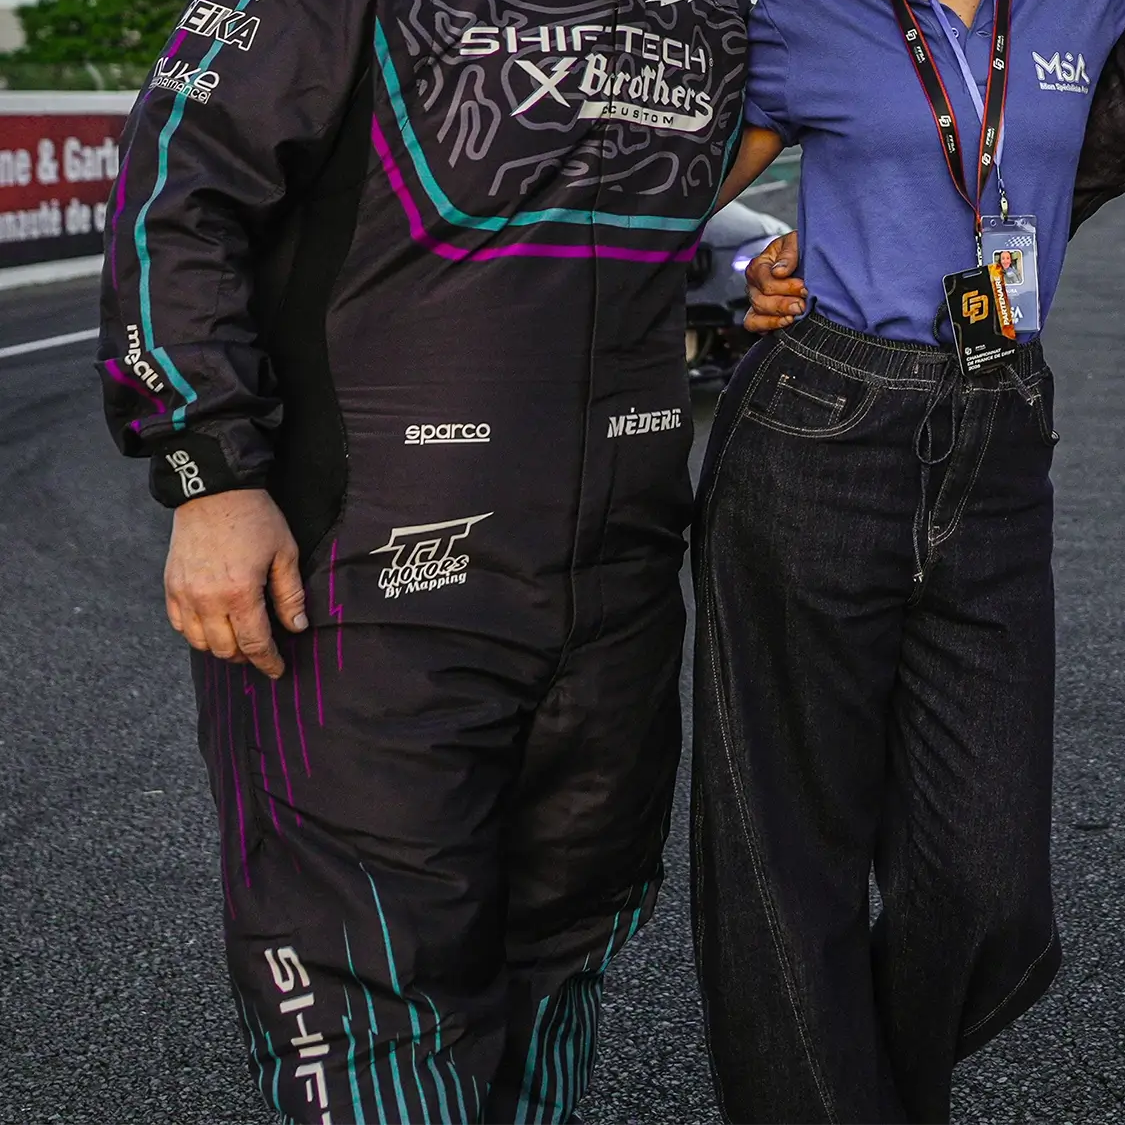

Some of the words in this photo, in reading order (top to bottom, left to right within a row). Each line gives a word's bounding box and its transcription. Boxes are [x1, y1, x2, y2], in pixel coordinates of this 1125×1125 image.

[459, 25, 707, 73] SHIFTECH
[511, 56, 578, 117] X
[578, 53, 714, 121] Brothers
[36, 137, 59, 184] &
[994, 276, 1011, 326] PARTENAIRE
[966, 348, 1001, 361] CHAMPIONNAT
[974, 355, 994, 364] FRANCE
[1001, 349, 1015, 357] DRIFT
[405, 423, 491, 445] sparco
[378, 555, 469, 589] MOTORS
[384, 580, 402, 598] By
[405, 571, 467, 594] Mapping
[264, 945, 332, 1125] SHIF
